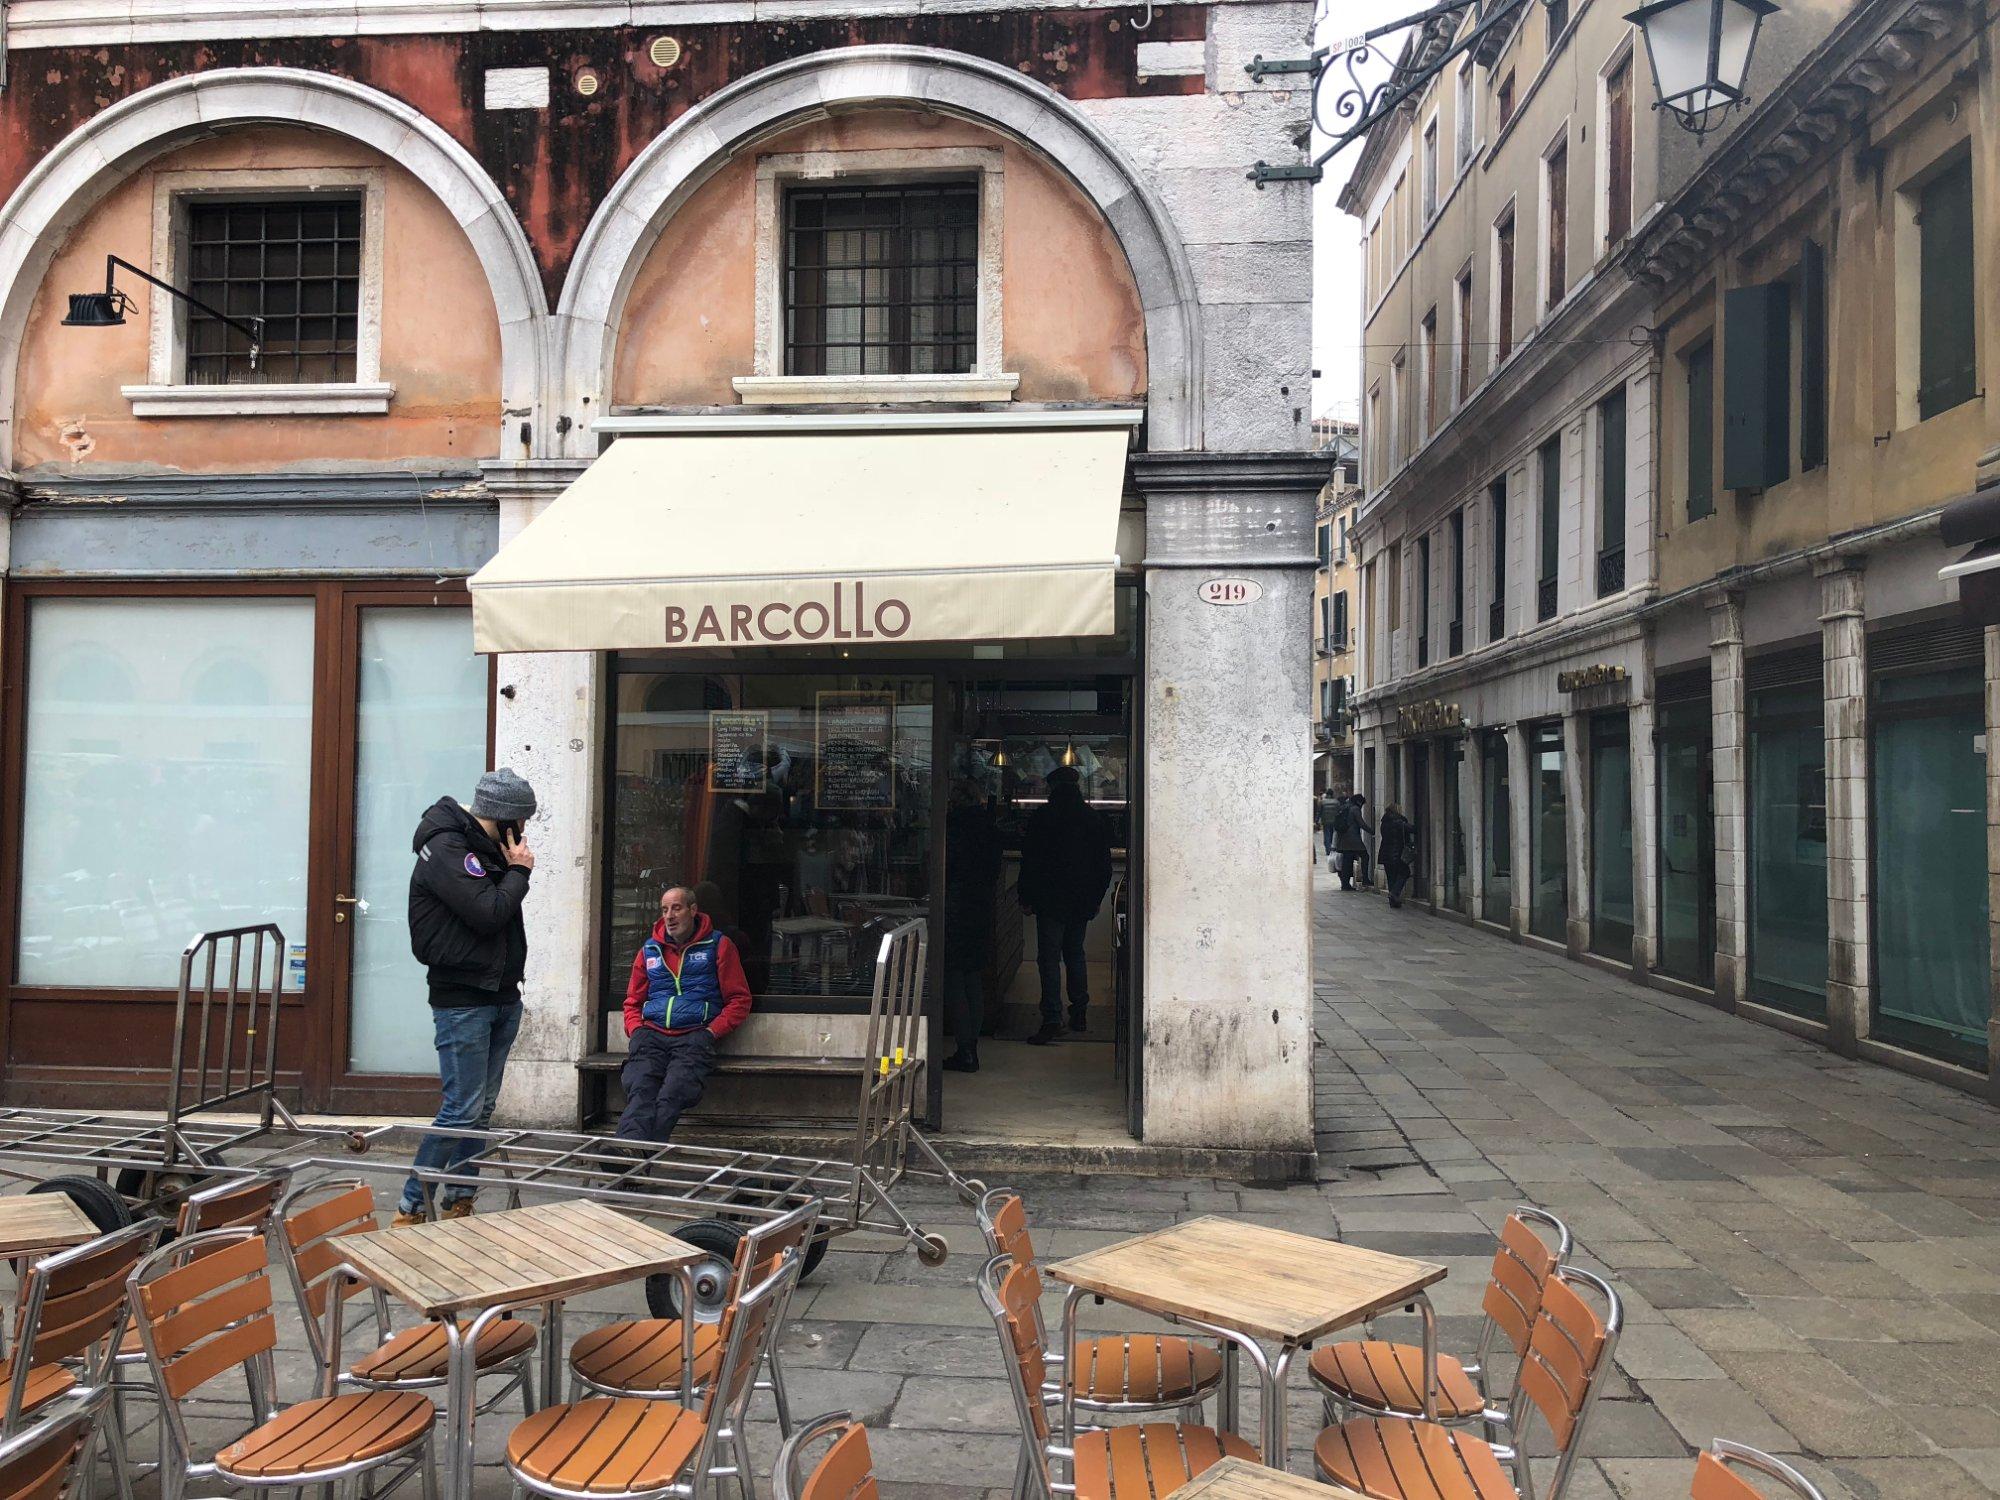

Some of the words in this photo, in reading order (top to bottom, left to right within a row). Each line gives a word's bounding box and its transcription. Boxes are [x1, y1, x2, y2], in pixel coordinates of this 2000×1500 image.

[1348, 35, 1365, 49] 002
[1209, 583, 1246, 600] 219
[665, 581, 911, 643] BARCOLLO
